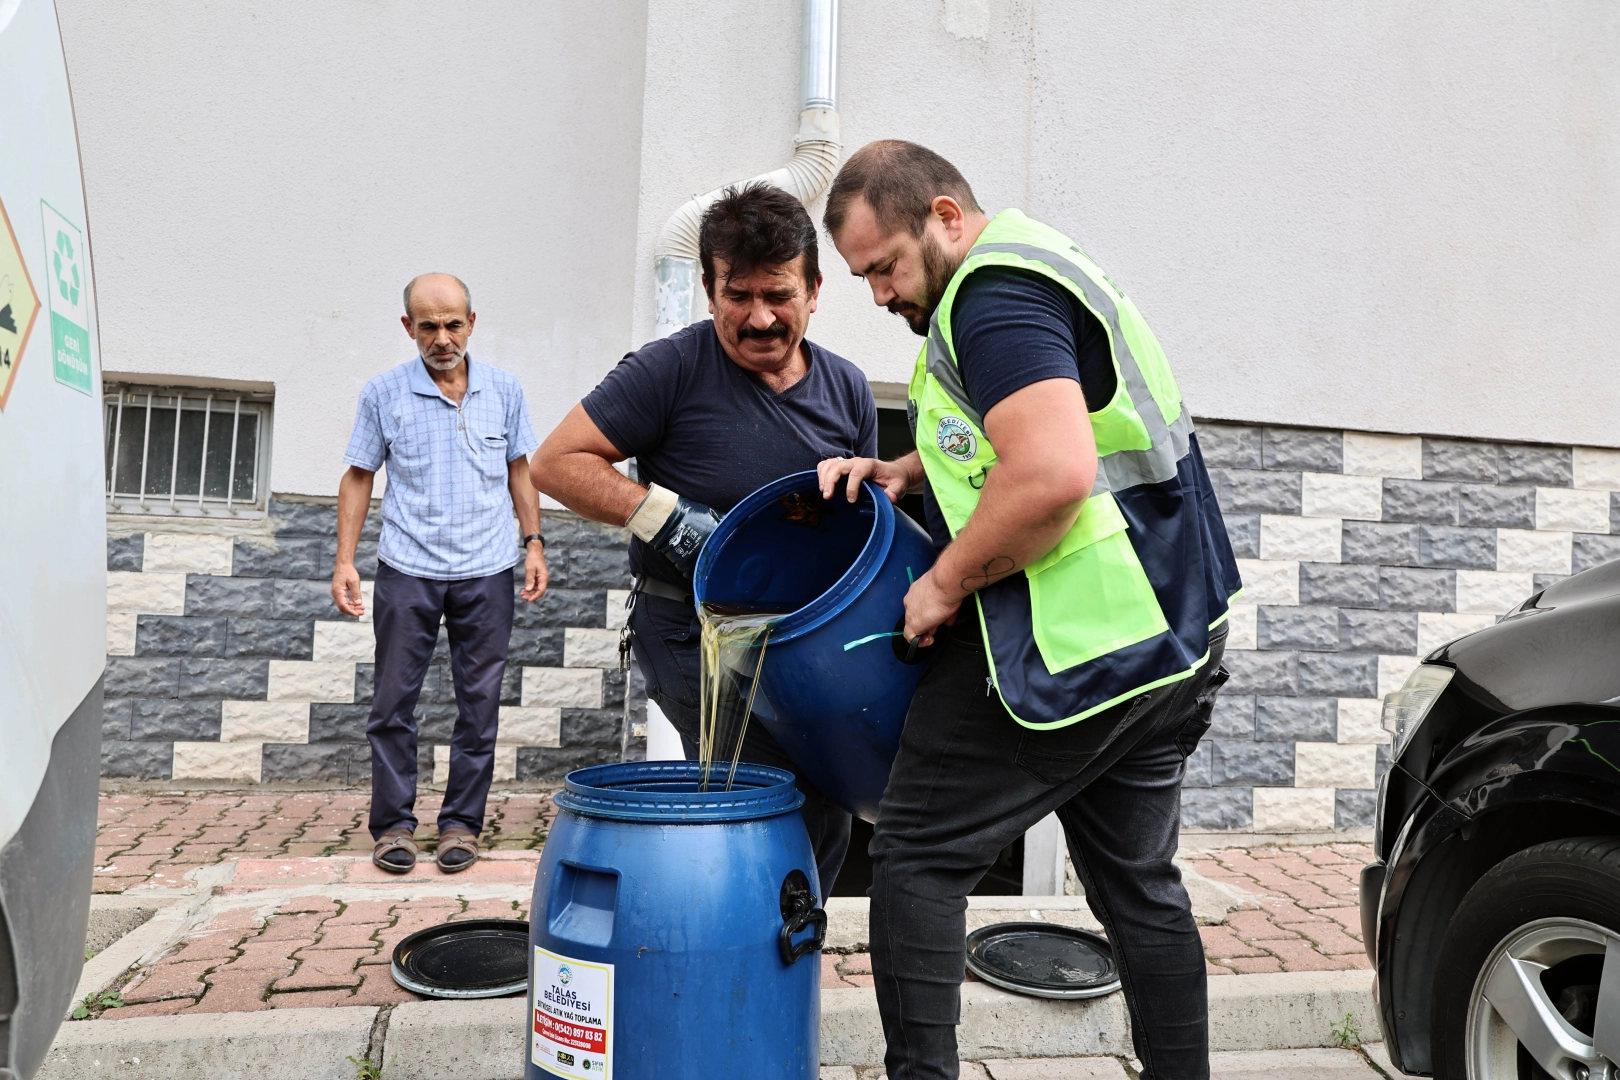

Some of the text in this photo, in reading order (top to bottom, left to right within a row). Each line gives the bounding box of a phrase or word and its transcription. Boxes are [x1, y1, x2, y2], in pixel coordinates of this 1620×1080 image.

[64, 334, 79, 353] GERİ
[57, 349, 88, 375] DÖNÜŞÜM
[544, 990, 590, 1011] BELEDİYESİ
[552, 984, 576, 1000] TALAS
[538, 1000, 602, 1026] BİTKİSEL ATIK YAĞ TOPLAMA
[573, 1028, 584, 1038] 897
[585, 1031, 593, 1040] 83
[594, 1032, 602, 1042] 82
